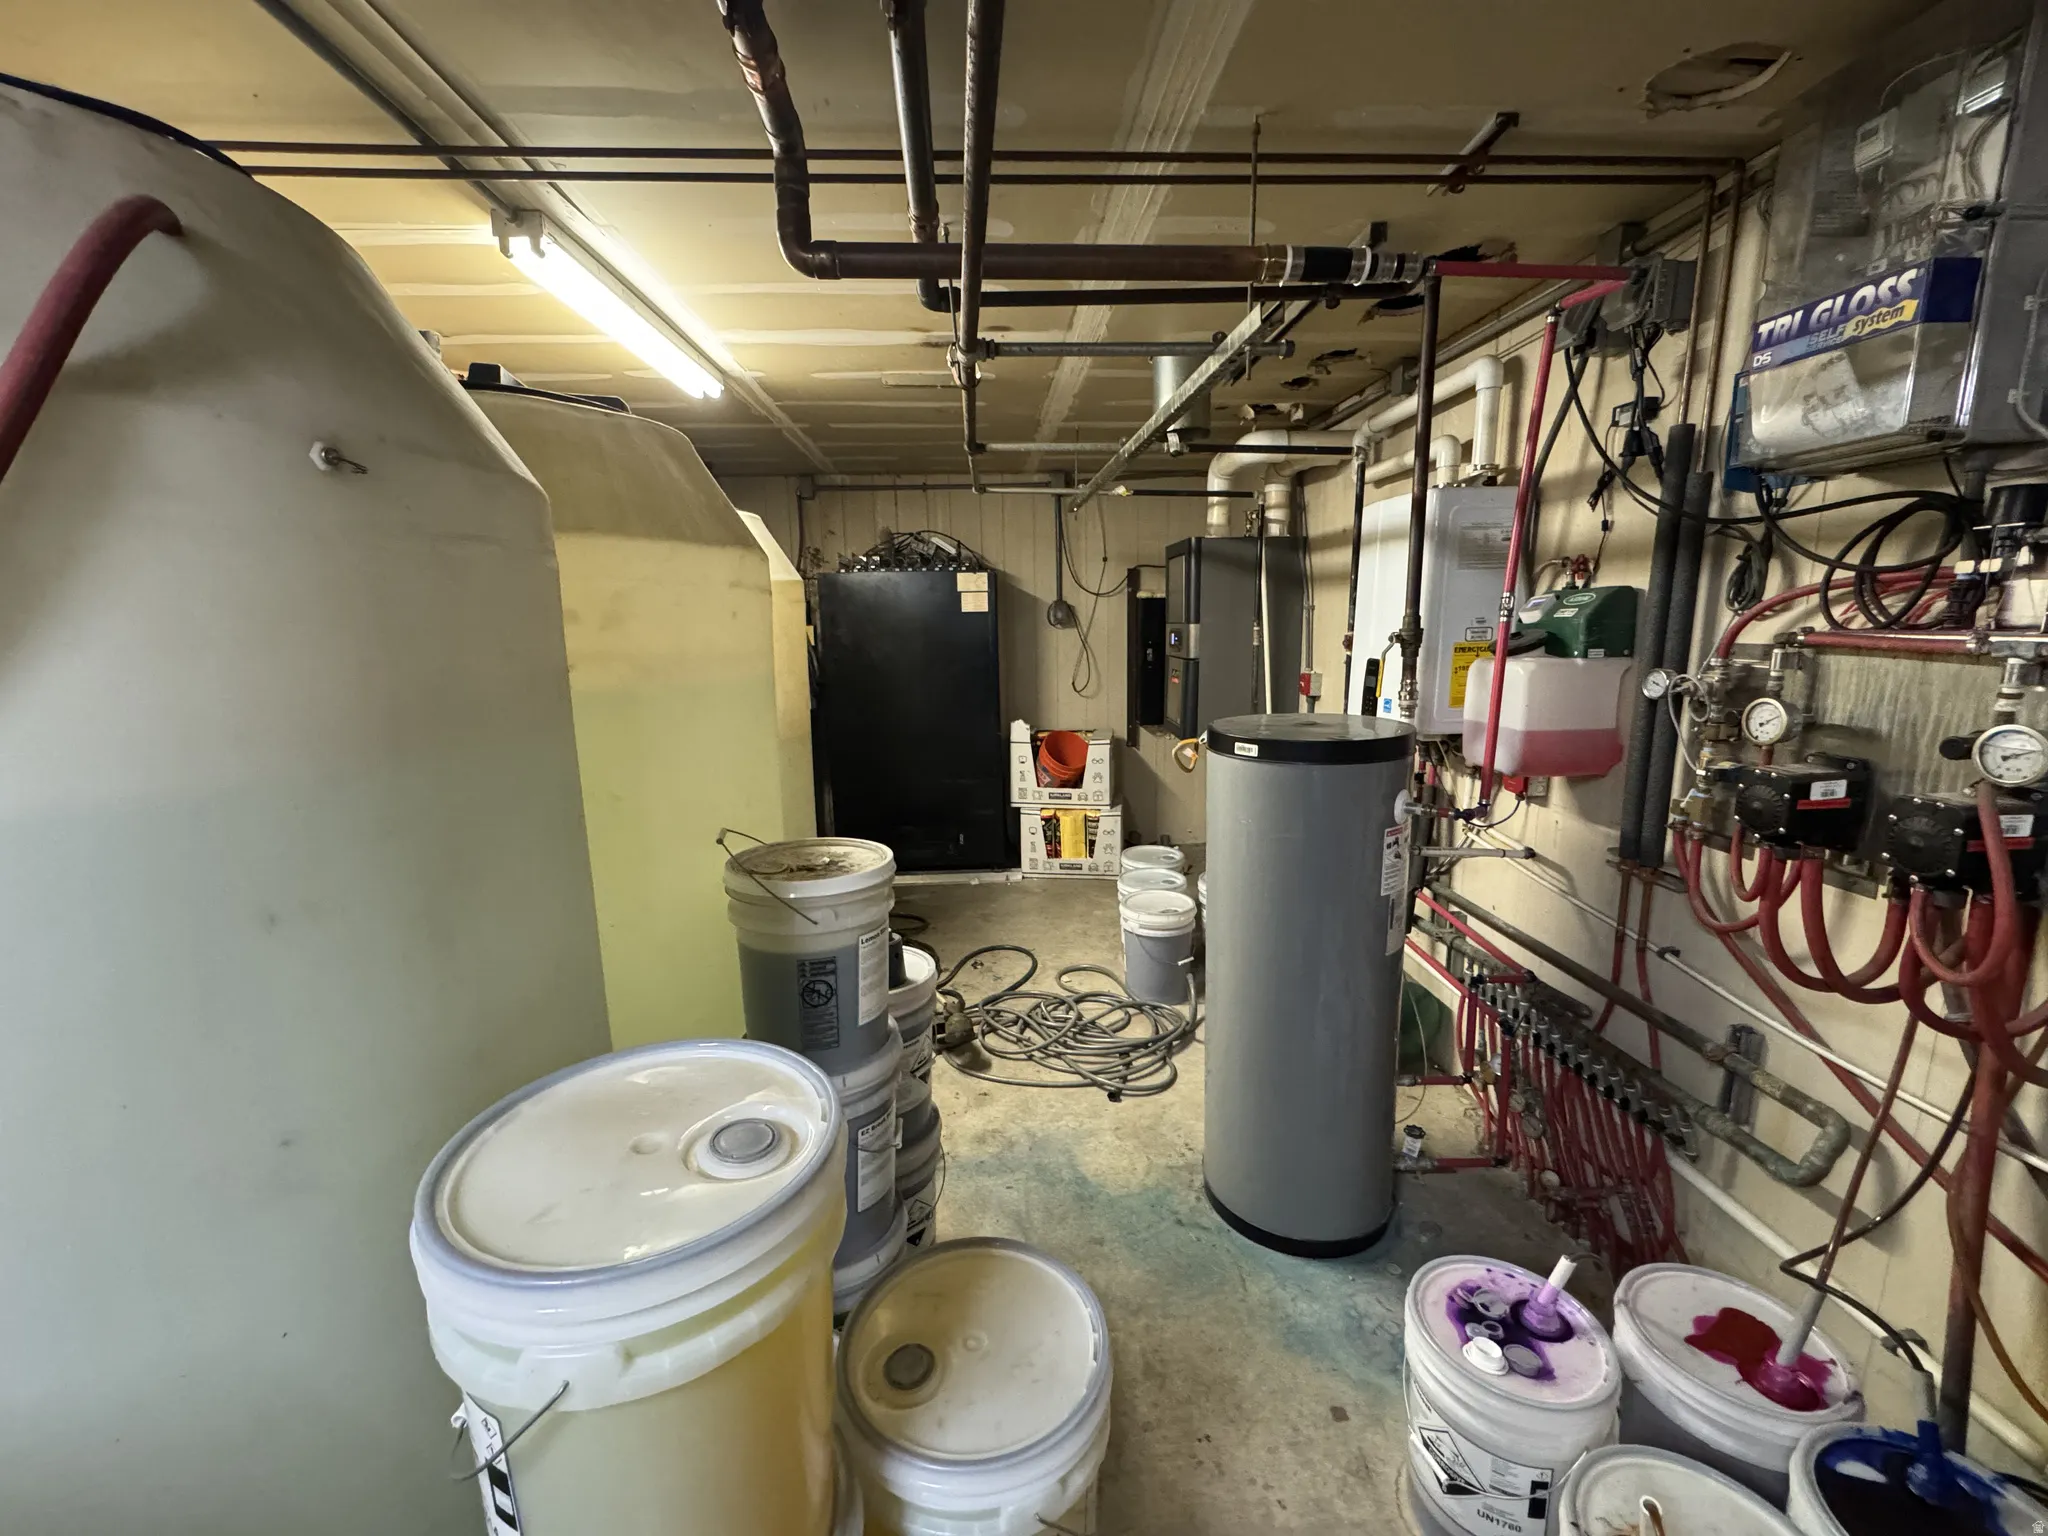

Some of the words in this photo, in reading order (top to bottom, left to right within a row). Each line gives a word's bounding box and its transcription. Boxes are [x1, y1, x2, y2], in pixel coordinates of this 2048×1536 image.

[1757, 309, 1804, 348] TRI
[1808, 267, 1919, 330] GLOSS
[1852, 304, 1904, 334] system
[1808, 324, 1847, 345] SELF
[1752, 351, 1773, 368] DS
[861, 931, 880, 945] Lemon
